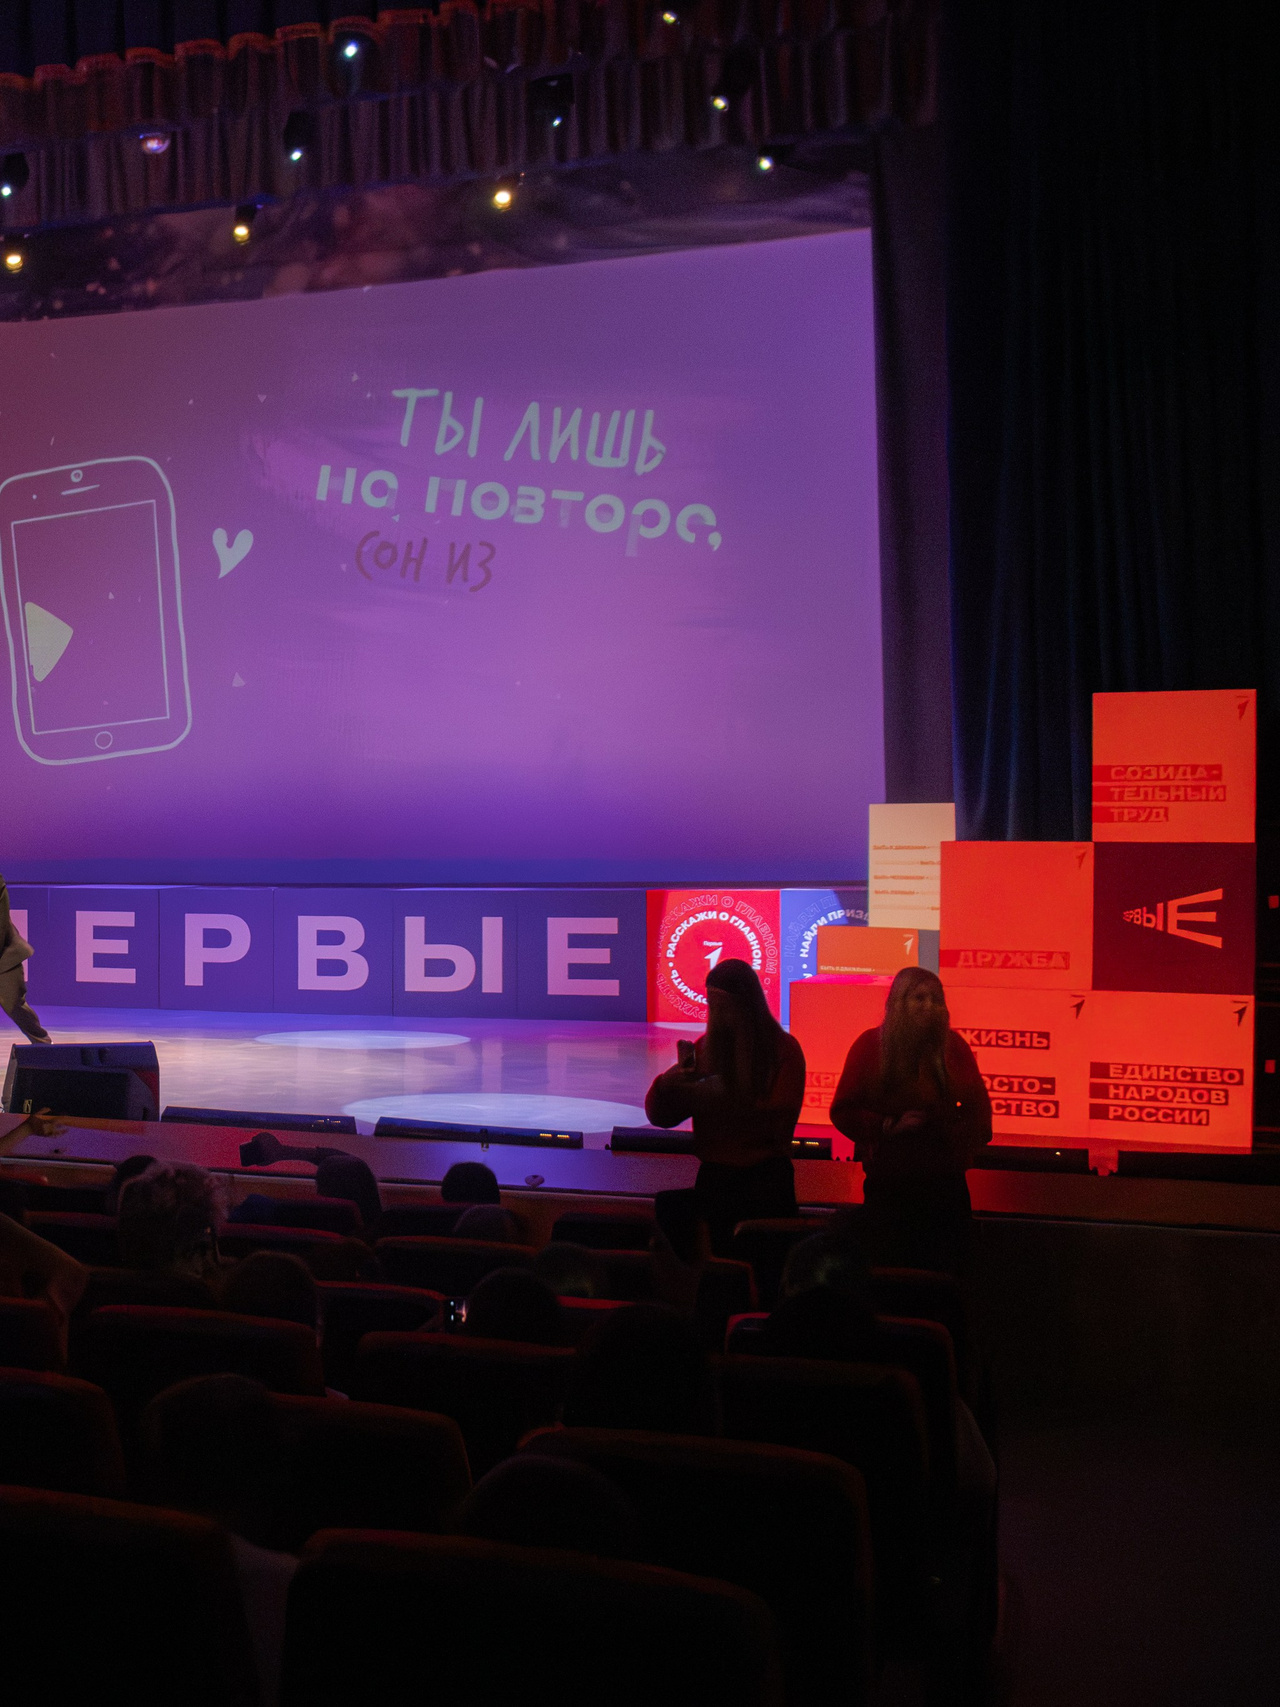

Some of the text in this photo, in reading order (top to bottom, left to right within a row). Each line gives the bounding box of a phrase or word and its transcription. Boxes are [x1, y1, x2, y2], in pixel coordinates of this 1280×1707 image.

[391, 387, 667, 476] ТЫ ЛИШЬ
[355, 530, 497, 593] СОН ИЗ
[1110, 766, 1220, 781] СОЗИДА-
[1110, 786, 1225, 801] ТЕЛЬНЫЙ
[1110, 808, 1166, 822] ТРУД
[666, 910, 762, 971] РАССКАЖИ О ГЛАВНОМ
[721, 896, 734, 908] О
[735, 901, 778, 974] ГЛАВНОМ
[800, 916, 828, 958] НАЙДИ
[957, 950, 1066, 969] ДРУЖБА
[656, 973, 707, 1020] РУЖИТЬ
[670, 969, 708, 1005] УЖИТЬ
[958, 1029, 1049, 1048] ЖИЗНЬ
[1109, 1064, 1241, 1083] ЕДИНСТВО
[982, 1076, 1052, 1093] СТО-
[1108, 1084, 1227, 1104] НАРОДОВ
[991, 1100, 1056, 1117] СТВО
[1108, 1106, 1208, 1125] РОССИИ
